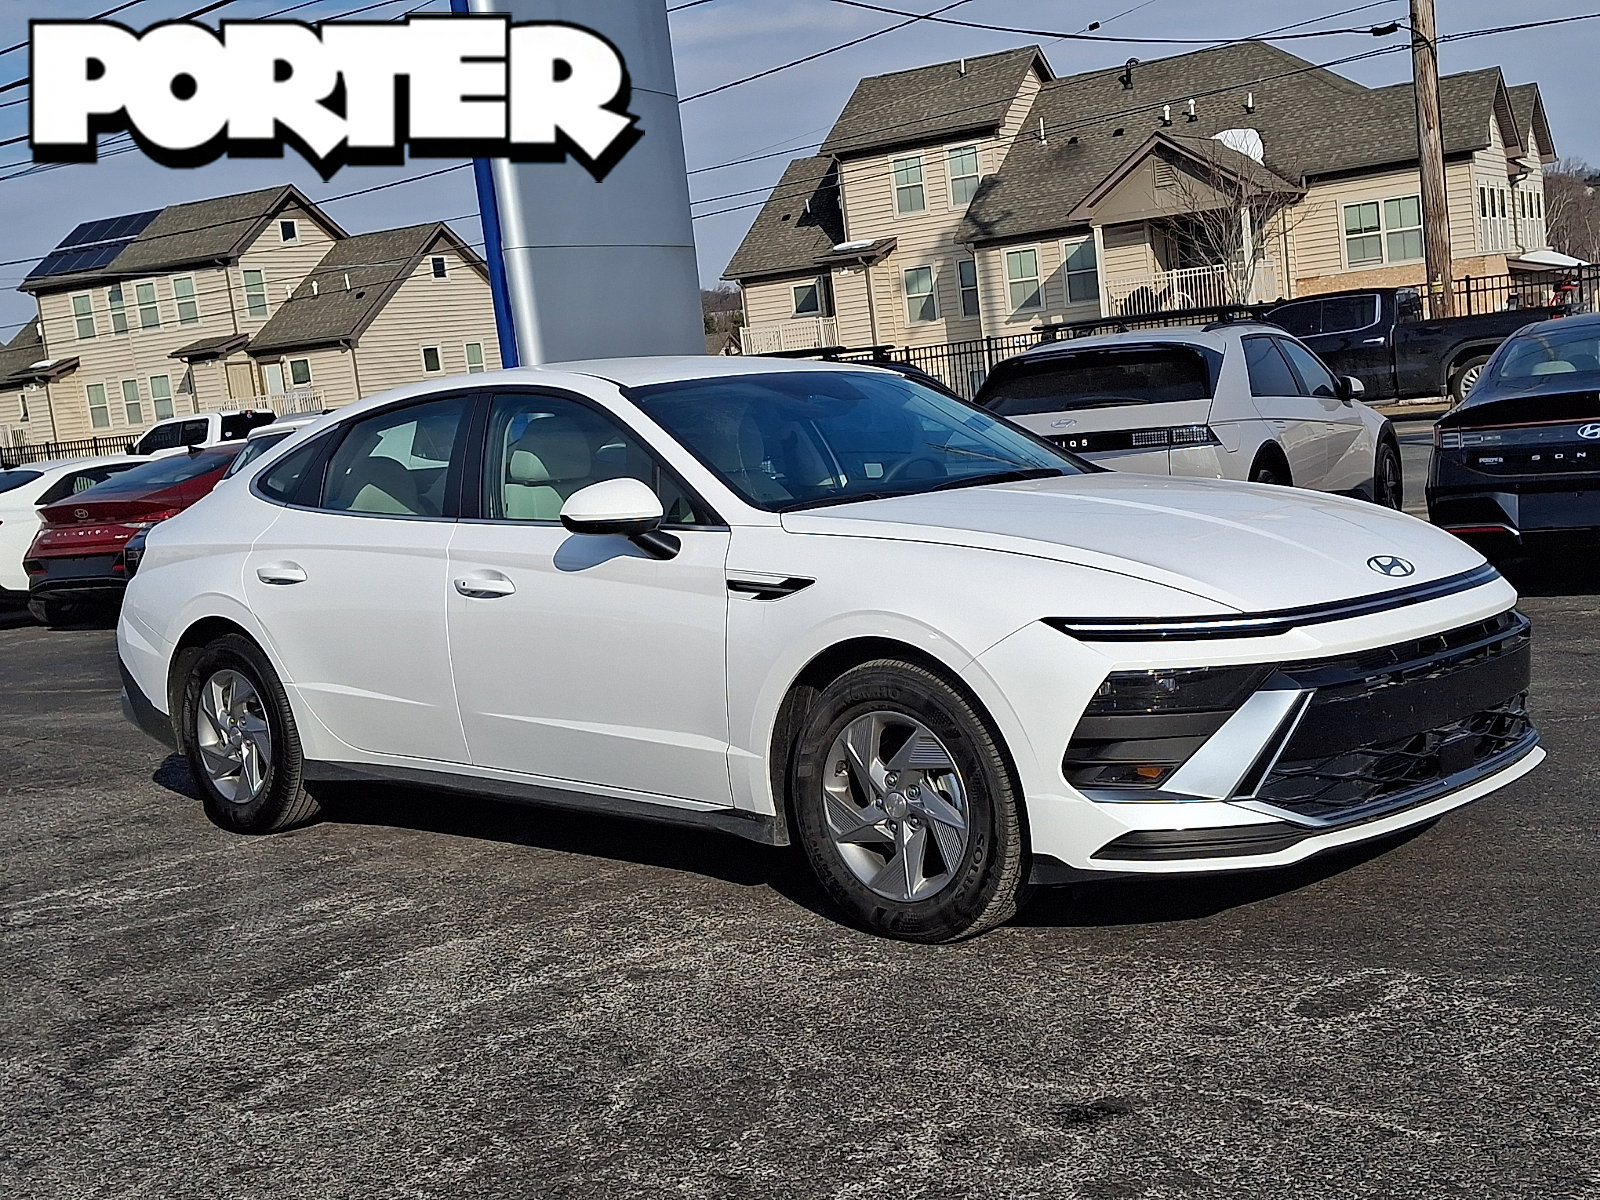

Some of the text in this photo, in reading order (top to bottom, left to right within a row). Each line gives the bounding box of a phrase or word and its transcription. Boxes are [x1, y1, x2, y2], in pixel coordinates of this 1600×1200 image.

[1081, 438, 1088, 447] 5
[1531, 451, 1587, 461] SON
[955, 832, 985, 900] SOLUS
